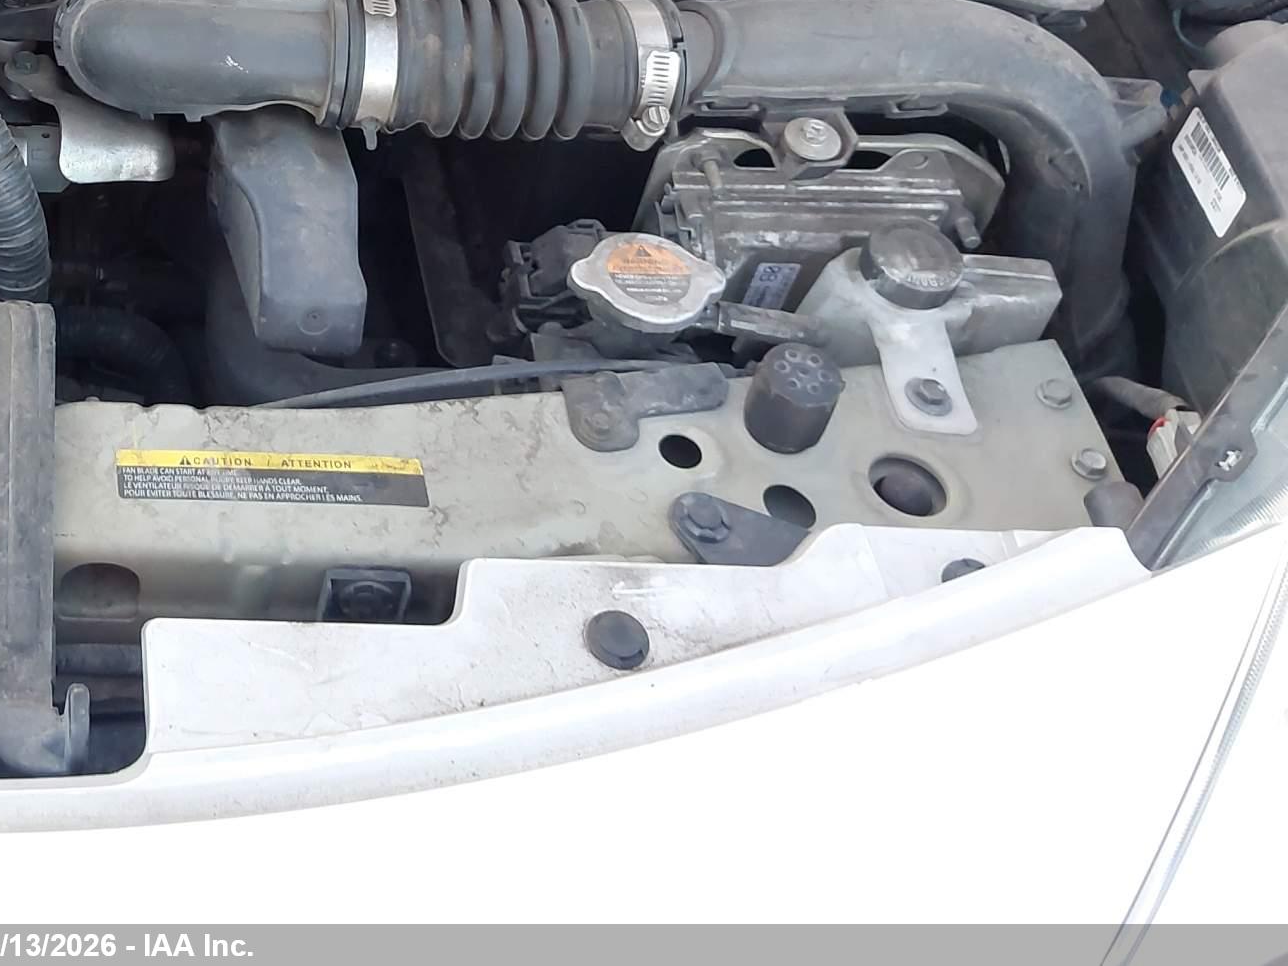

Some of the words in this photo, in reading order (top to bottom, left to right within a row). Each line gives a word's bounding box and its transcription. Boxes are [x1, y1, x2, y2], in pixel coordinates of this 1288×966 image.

[193, 457, 252, 466] CAUTION
[281, 459, 352, 469] ATTENTION
[122, 467, 136, 475] FAN
[159, 467, 175, 475] CAN
[197, 468, 206, 476] AT
[124, 474, 133, 482] TO
[134, 474, 152, 482] HELP
[174, 475, 210, 483] PERSONAL
[133, 482, 182, 490] VENTILATEUR
[124, 489, 146, 497] POUR
[172, 490, 197, 498] TOUTE
[248, 492, 263, 500] PAS
[264, 492, 275, 500] EN
[276, 493, 321, 501] APPROCHER
